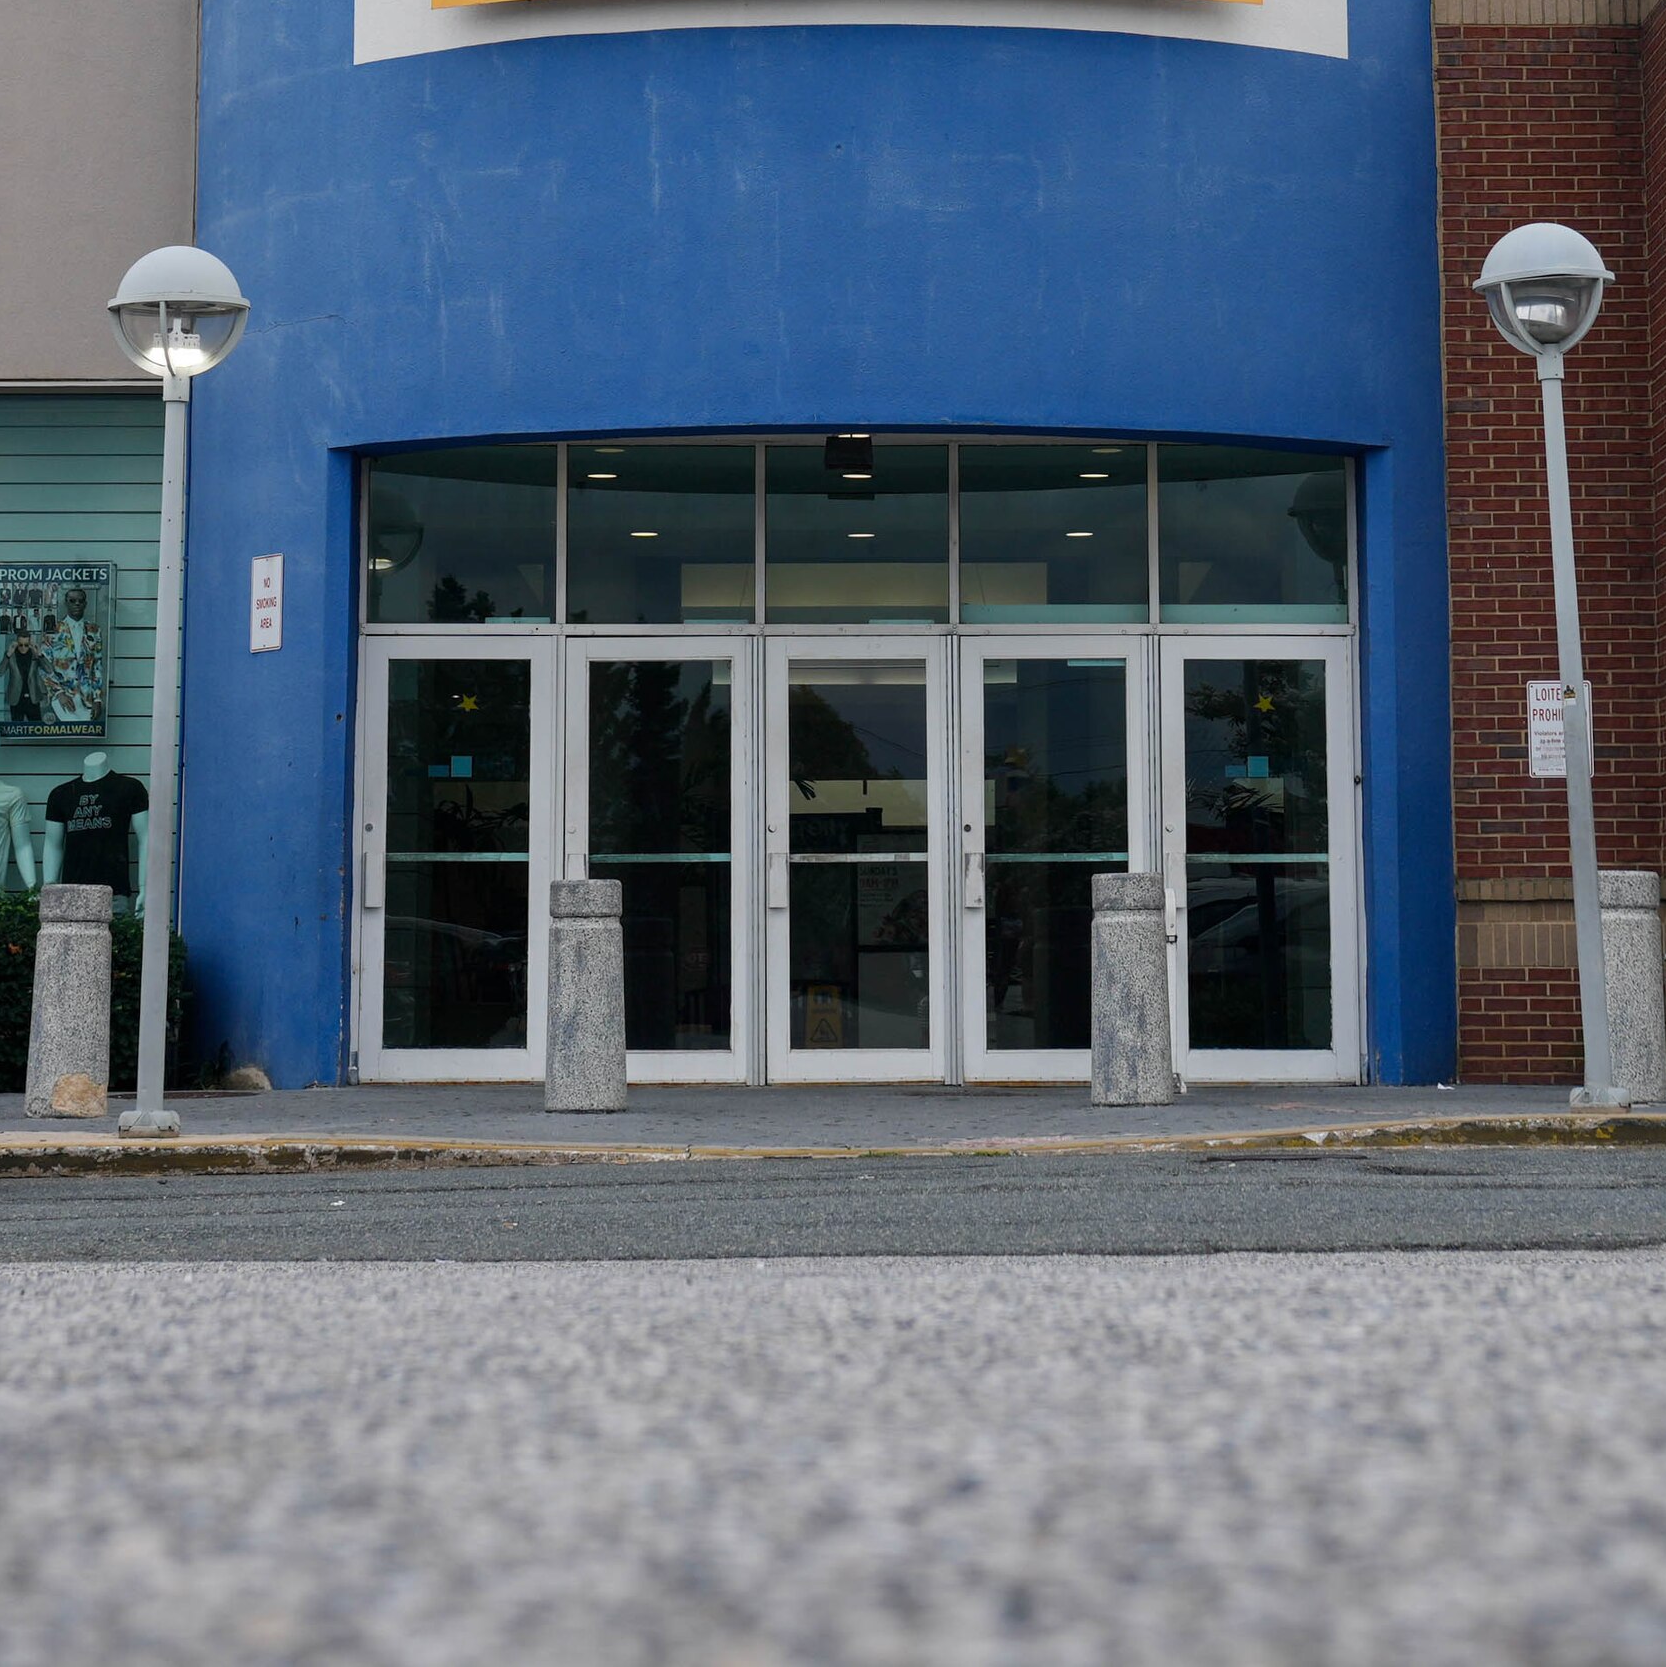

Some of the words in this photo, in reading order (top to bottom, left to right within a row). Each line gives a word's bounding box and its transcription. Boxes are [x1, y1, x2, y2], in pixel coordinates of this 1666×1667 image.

[45, 568, 108, 581] JACKETS
[1535, 687, 1562, 702] LOITE
[1532, 708, 1564, 722] PROHI
[2, 724, 103, 734] MARTFORMALWEAR
[78, 793, 100, 806] BY
[73, 804, 103, 819] ANY
[67, 816, 113, 833] MEANS
